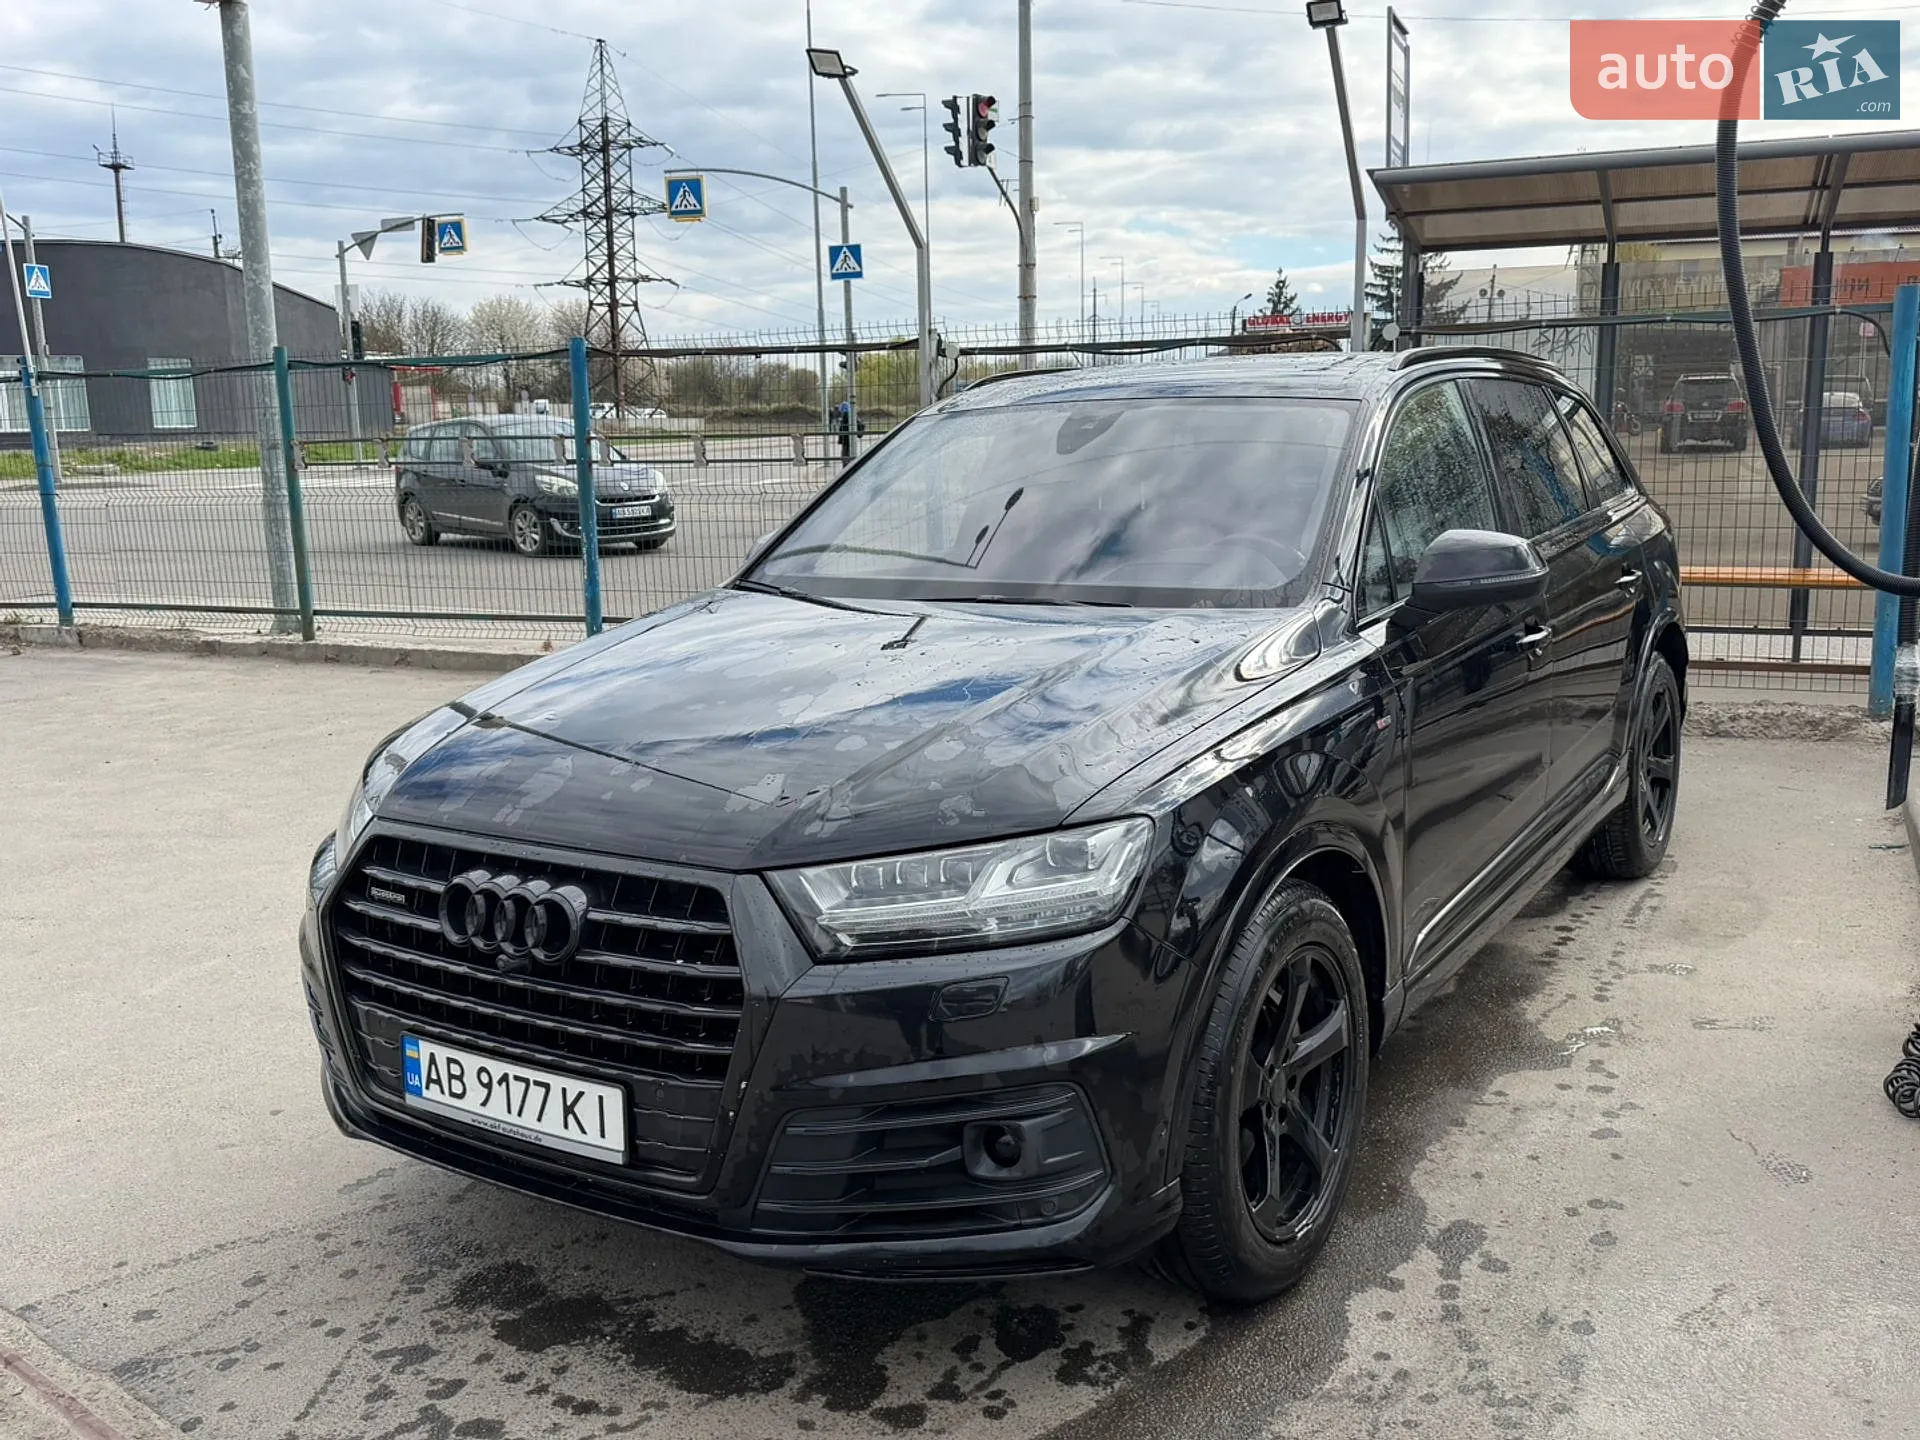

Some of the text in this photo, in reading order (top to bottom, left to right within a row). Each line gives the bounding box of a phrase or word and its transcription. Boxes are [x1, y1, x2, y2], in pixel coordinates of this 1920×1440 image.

[407, 1072, 421, 1088] UA
[425, 1051, 606, 1139] AB 9177 KI
